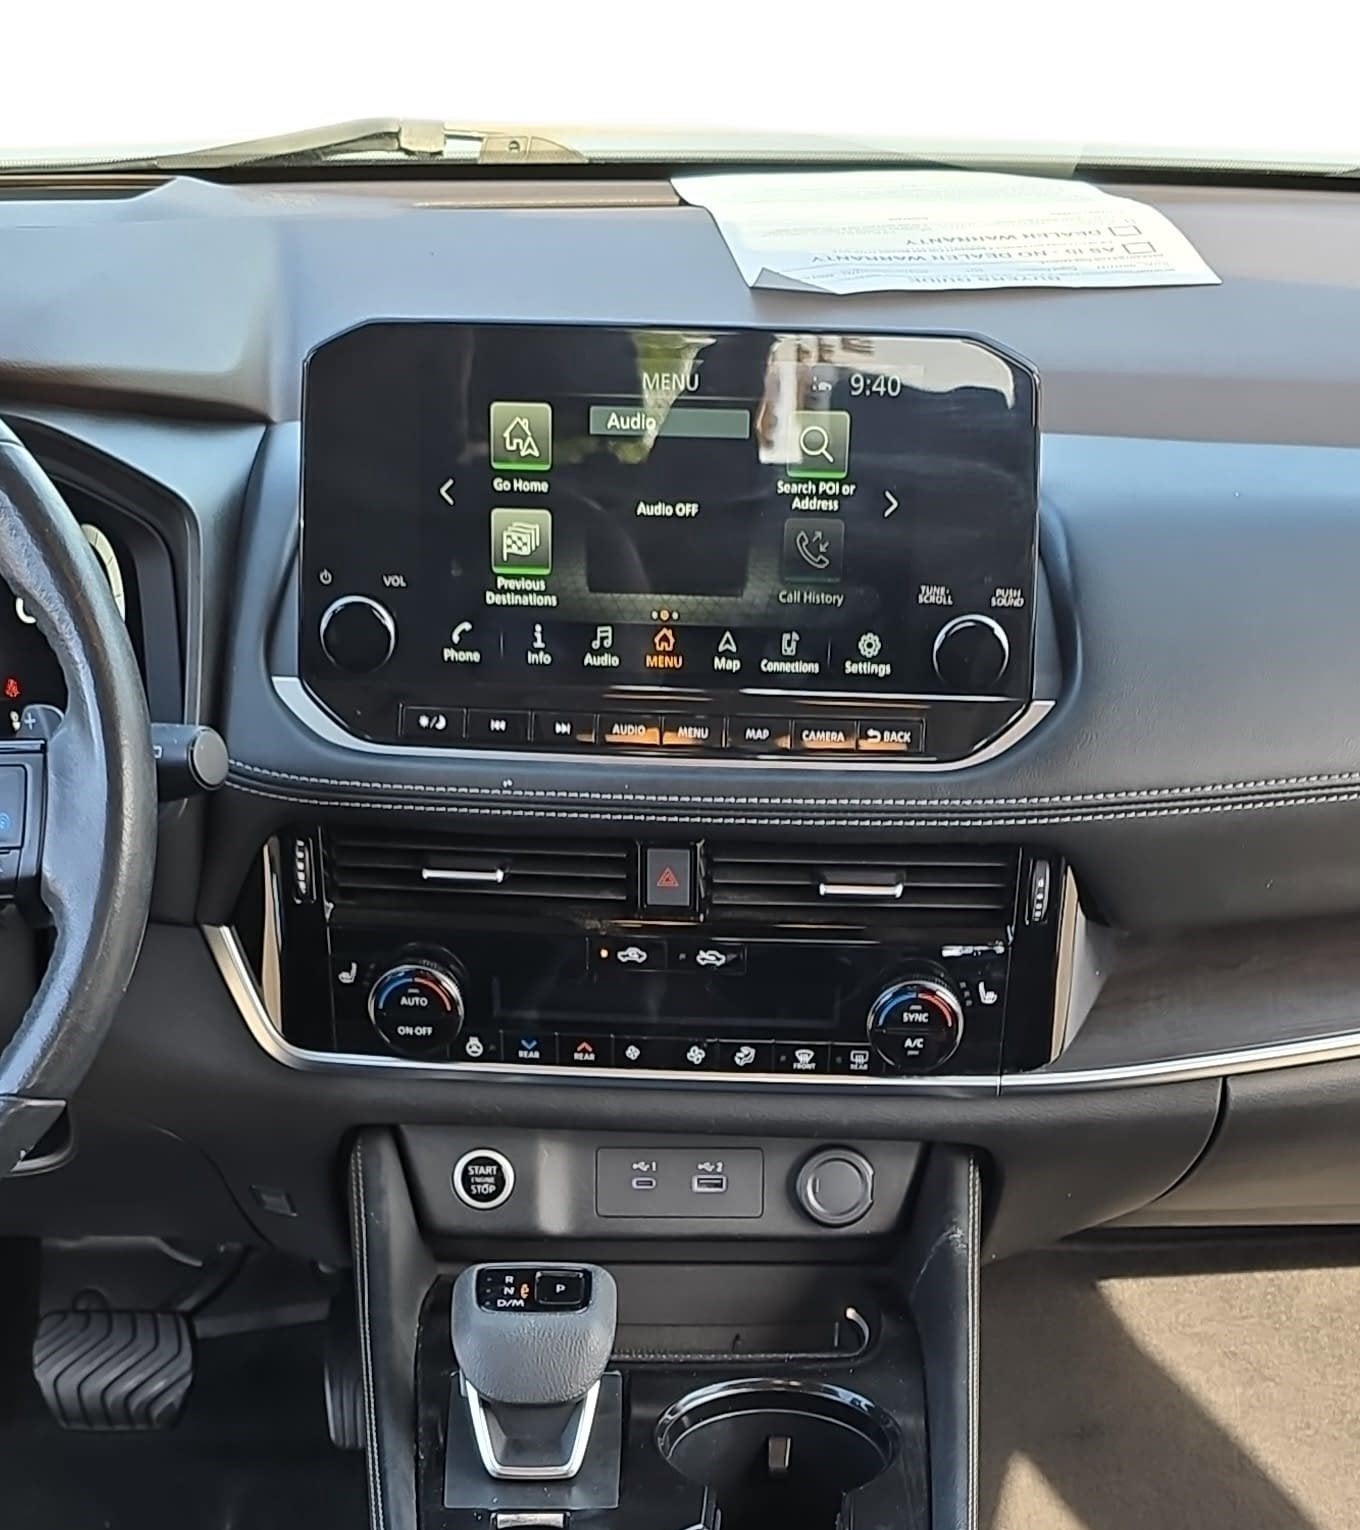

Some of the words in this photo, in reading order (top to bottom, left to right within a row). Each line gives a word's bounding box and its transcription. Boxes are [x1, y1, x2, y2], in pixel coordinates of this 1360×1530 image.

[642, 373, 699, 392] MENU
[850, 373, 902, 396] 9:40
[608, 412, 656, 431] Audio
[493, 479, 510, 492] Go
[514, 479, 548, 492] Home
[777, 480, 815, 494] Search
[818, 482, 840, 495] POI
[841, 485, 856, 496] or
[637, 502, 672, 516] Audio
[675, 503, 699, 517] OFF
[792, 496, 839, 511] Address
[384, 575, 406, 587] VOL
[497, 578, 546, 591] Previous
[486, 591, 557, 606] Destinations
[778, 590, 799, 605] Call
[803, 590, 843, 607] History
[443, 649, 480, 663] Phone
[528, 651, 551, 666] Info
[584, 652, 619, 668] Audio
[646, 654, 682, 668] MENU
[714, 656, 741, 673] Map
[761, 659, 819, 674] Connections
[845, 661, 891, 676] Settings
[612, 724, 645, 737] AUDIO
[678, 726, 709, 739] MENU
[746, 728, 769, 741] MAP
[802, 729, 845, 742] CAMERA
[883, 731, 911, 744] BACK
[400, 996, 428, 1007] AUTO
[903, 1012, 929, 1023] SYNC
[904, 1037, 924, 1049] A/C
[518, 1050, 540, 1059] REAR
[573, 1052, 595, 1061] REAR
[793, 1061, 816, 1070] FRONT
[467, 1165, 497, 1175] START
[470, 1184, 496, 1194] STOP
[505, 1275, 514, 1283] R
[503, 1287, 515, 1295] N
[556, 1284, 566, 1293] P
[497, 1299, 524, 1307] D/M
